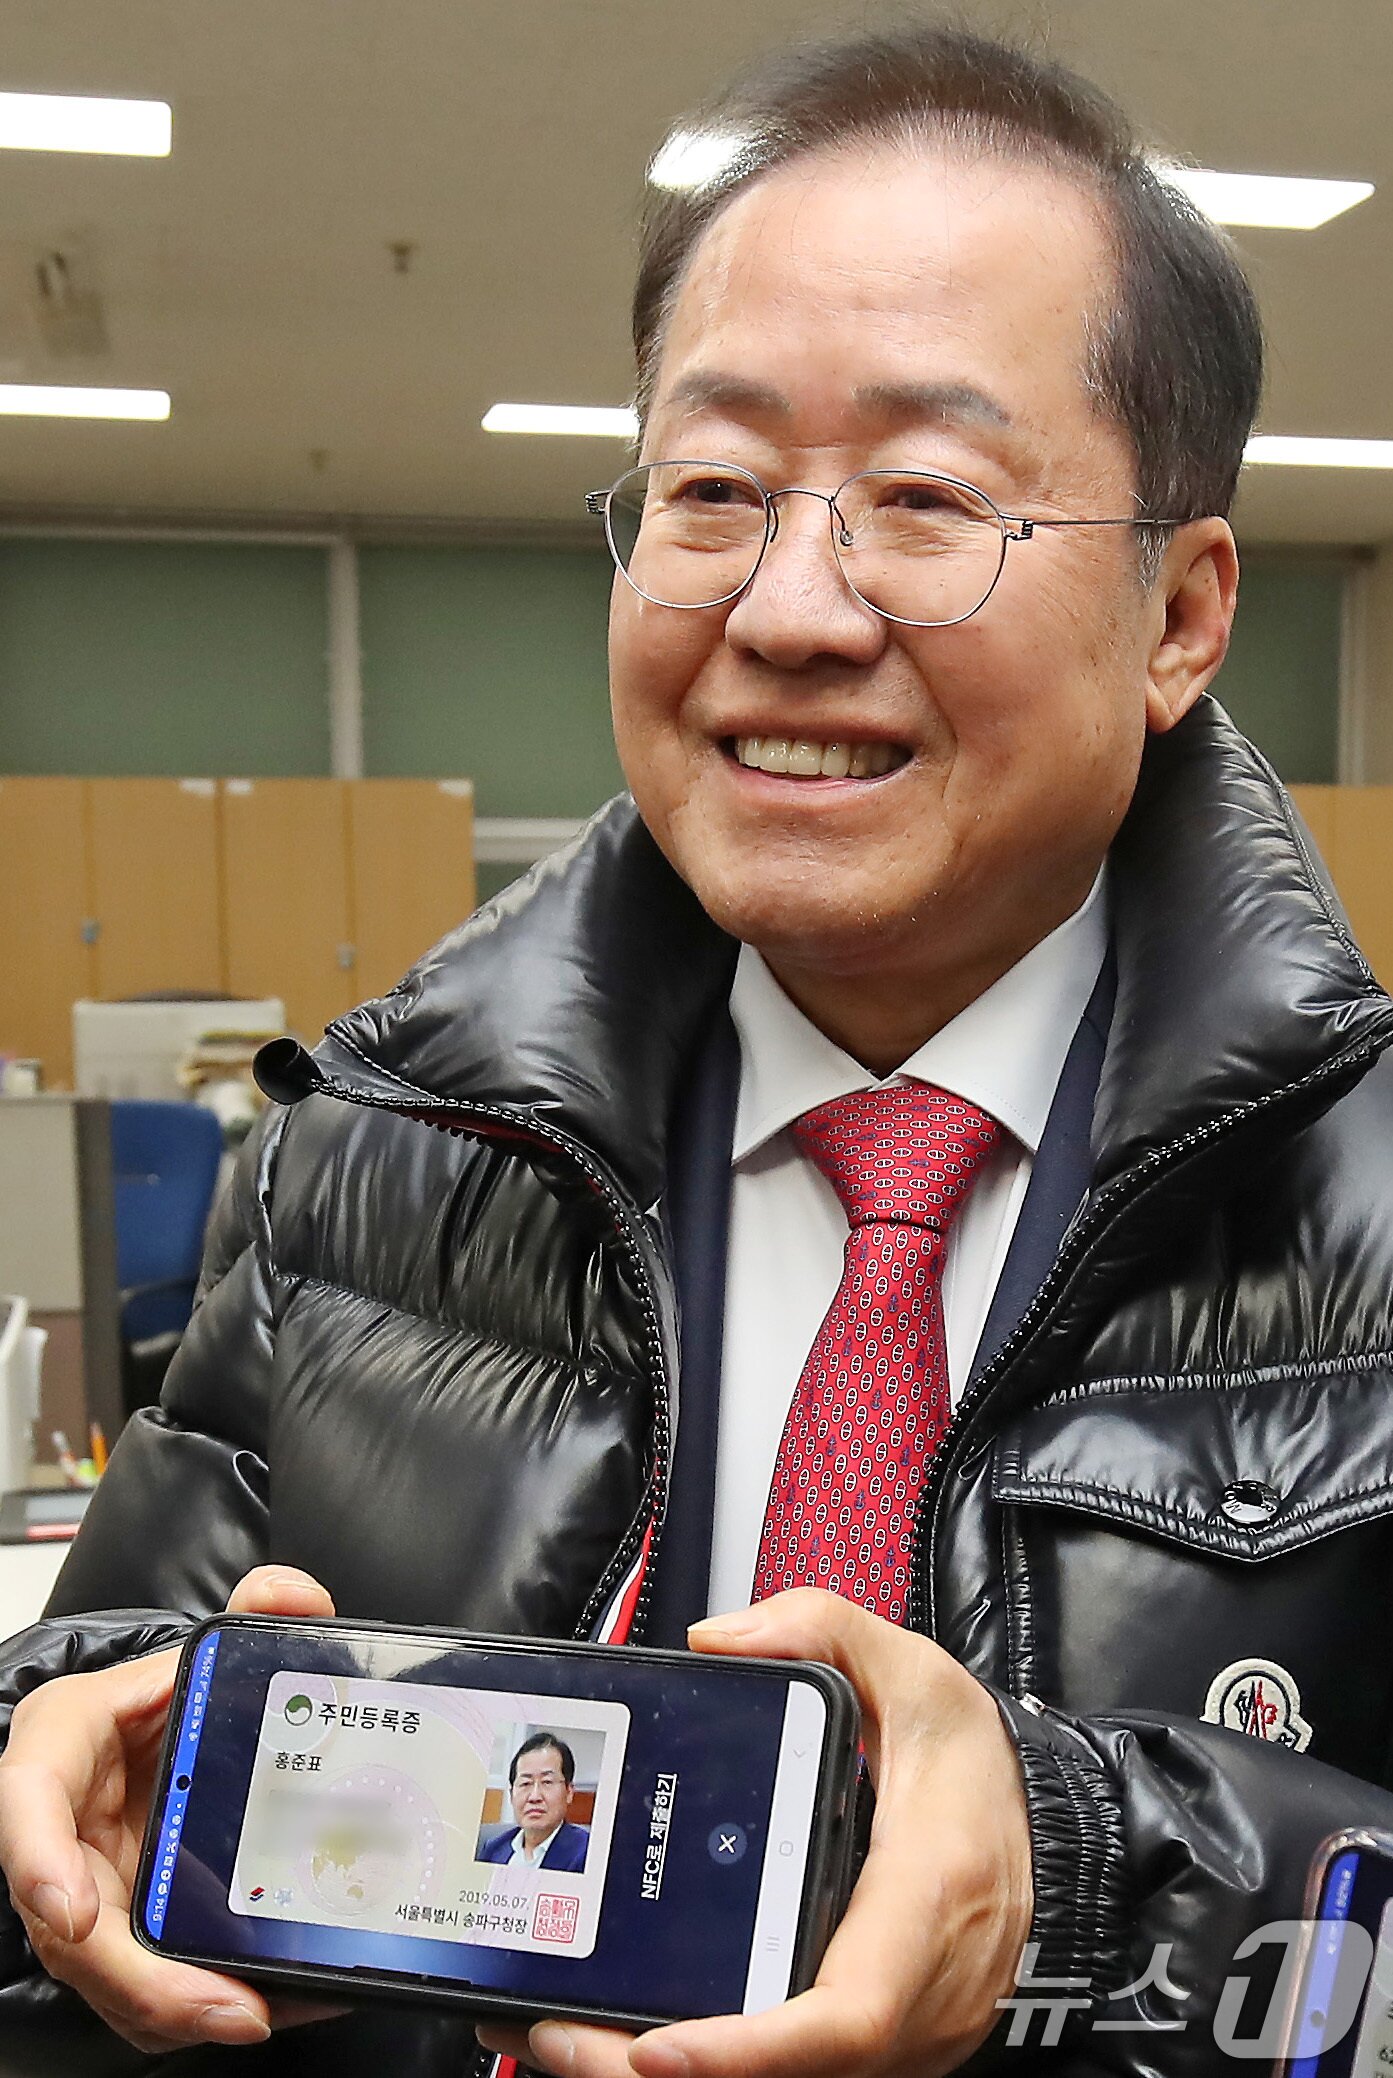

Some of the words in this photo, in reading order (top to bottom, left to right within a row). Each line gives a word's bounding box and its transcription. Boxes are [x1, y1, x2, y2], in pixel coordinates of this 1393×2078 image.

[318, 1703, 421, 1734] 주민등록증
[275, 1752, 322, 1771] 홍준표
[650, 1773, 675, 1839] 제출하기
[641, 1844, 662, 1899] NFC로
[395, 1904, 459, 1926] 서울특별시
[463, 1912, 528, 1935] 송파구청장
